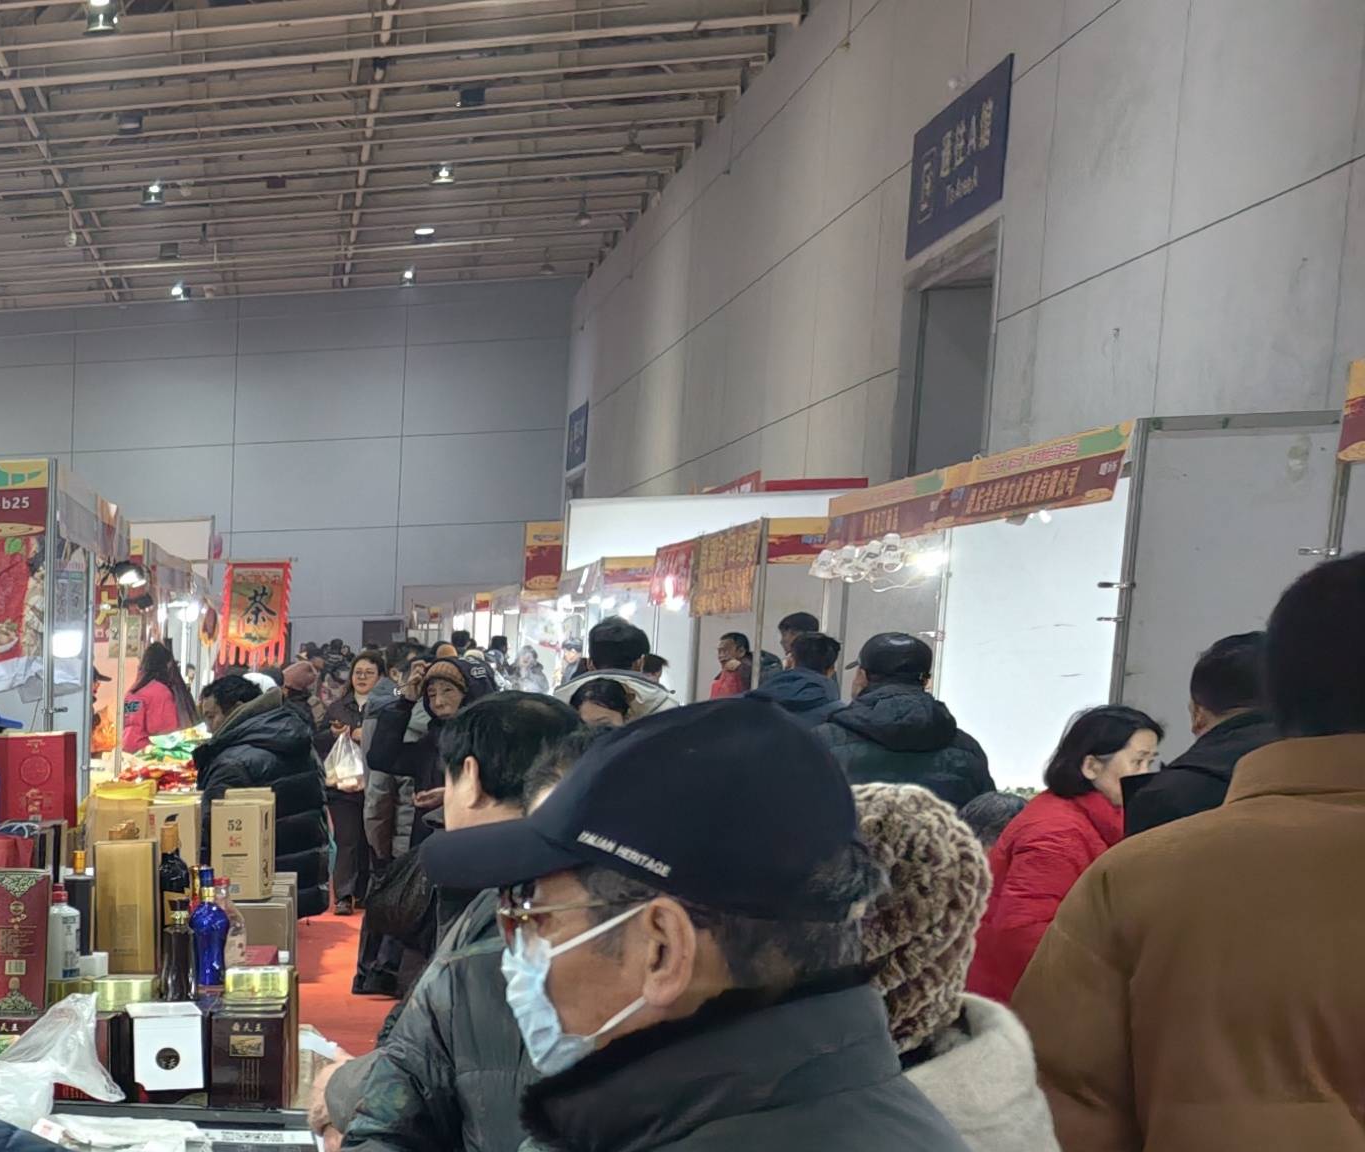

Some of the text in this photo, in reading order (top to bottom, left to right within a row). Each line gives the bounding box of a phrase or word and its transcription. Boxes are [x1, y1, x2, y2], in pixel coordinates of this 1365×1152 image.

[241, 586, 277, 626] 茶
[227, 818, 243, 832] 52
[576, 829, 672, 880] ITALIAN HERITAGE
